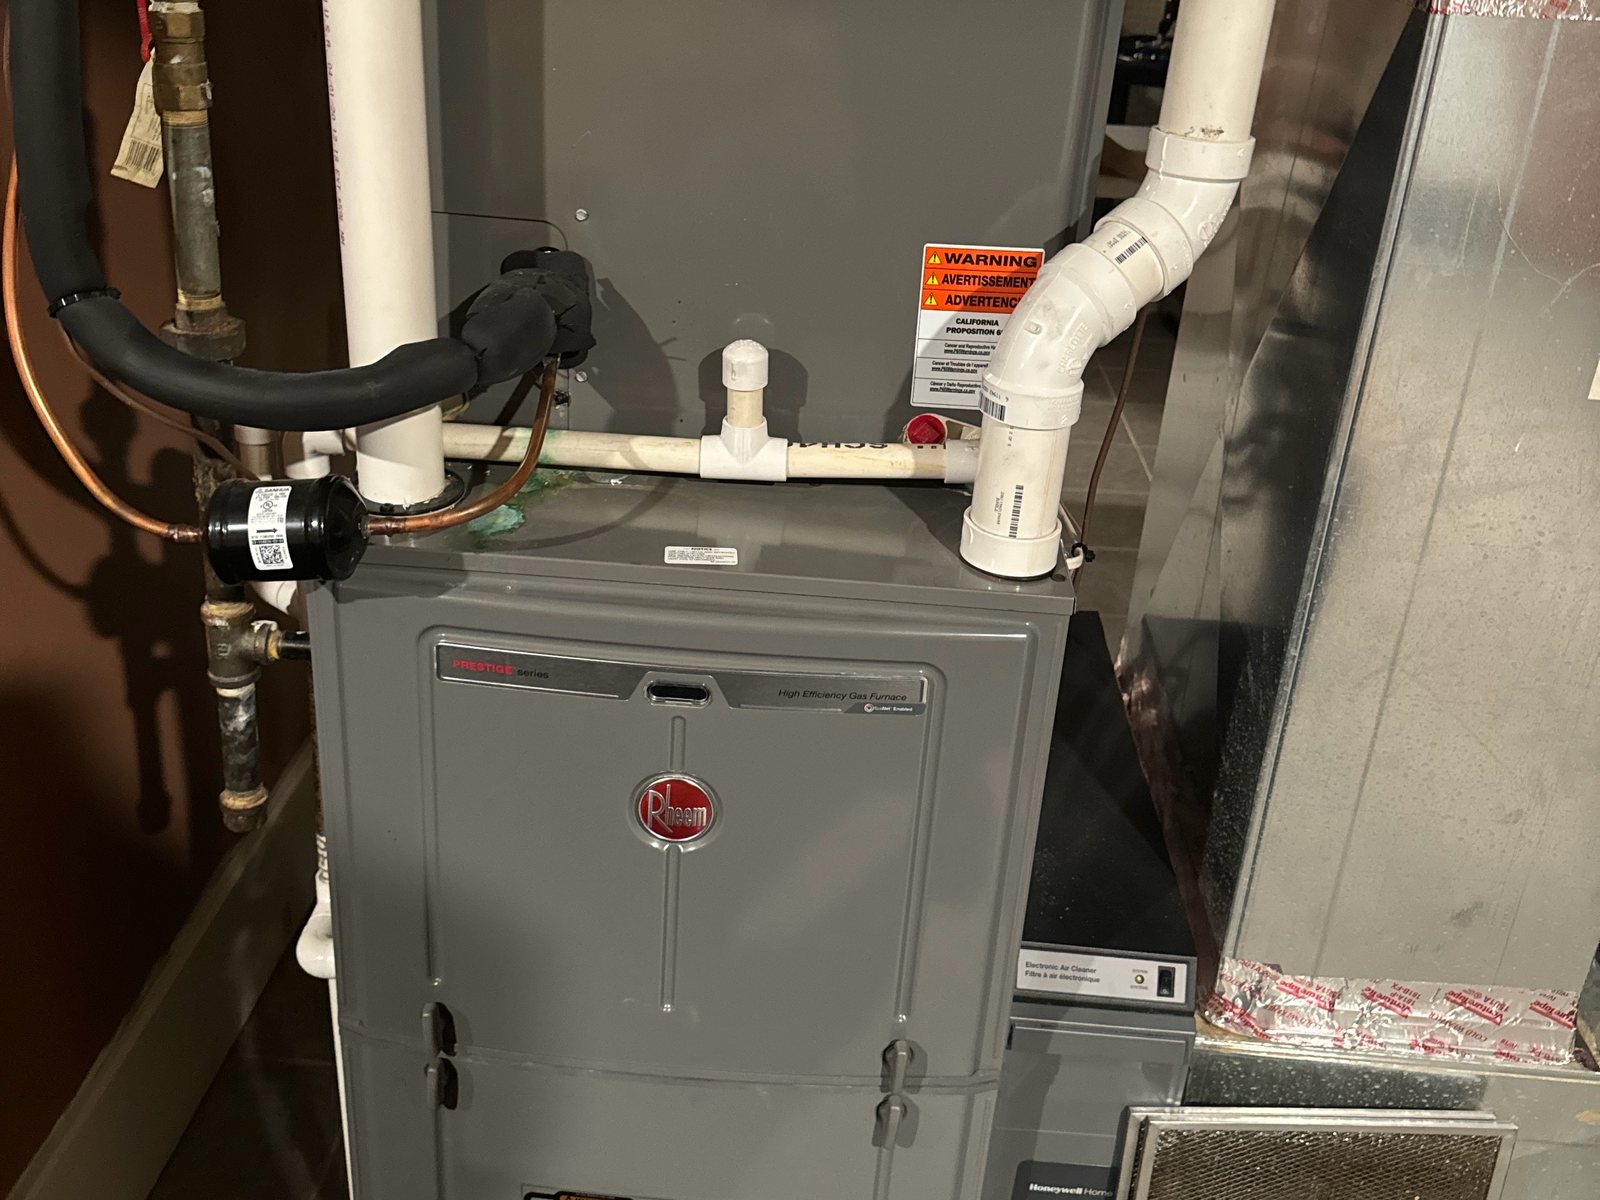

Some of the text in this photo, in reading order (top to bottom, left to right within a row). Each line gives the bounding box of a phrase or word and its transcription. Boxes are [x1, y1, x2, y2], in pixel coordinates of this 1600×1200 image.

[944, 252, 1038, 268] WARNING
[941, 273, 1036, 289] AVERTISSEMENT
[944, 294, 1021, 308] ADVERTENC
[955, 318, 1000, 327] CALIFORNIA
[945, 327, 995, 336] PROPOSITION
[452, 659, 549, 679] PRESTIGE series
[778, 689, 907, 701] High Efficiency Gas Furnace
[647, 784, 707, 833] Rheem
[1025, 961, 1097, 974] Electronic Air Cleaner
[1024, 970, 1042, 978] Filtre
[1059, 973, 1100, 983] électronique
[1029, 1183, 1114, 1197] Honeywell Home
